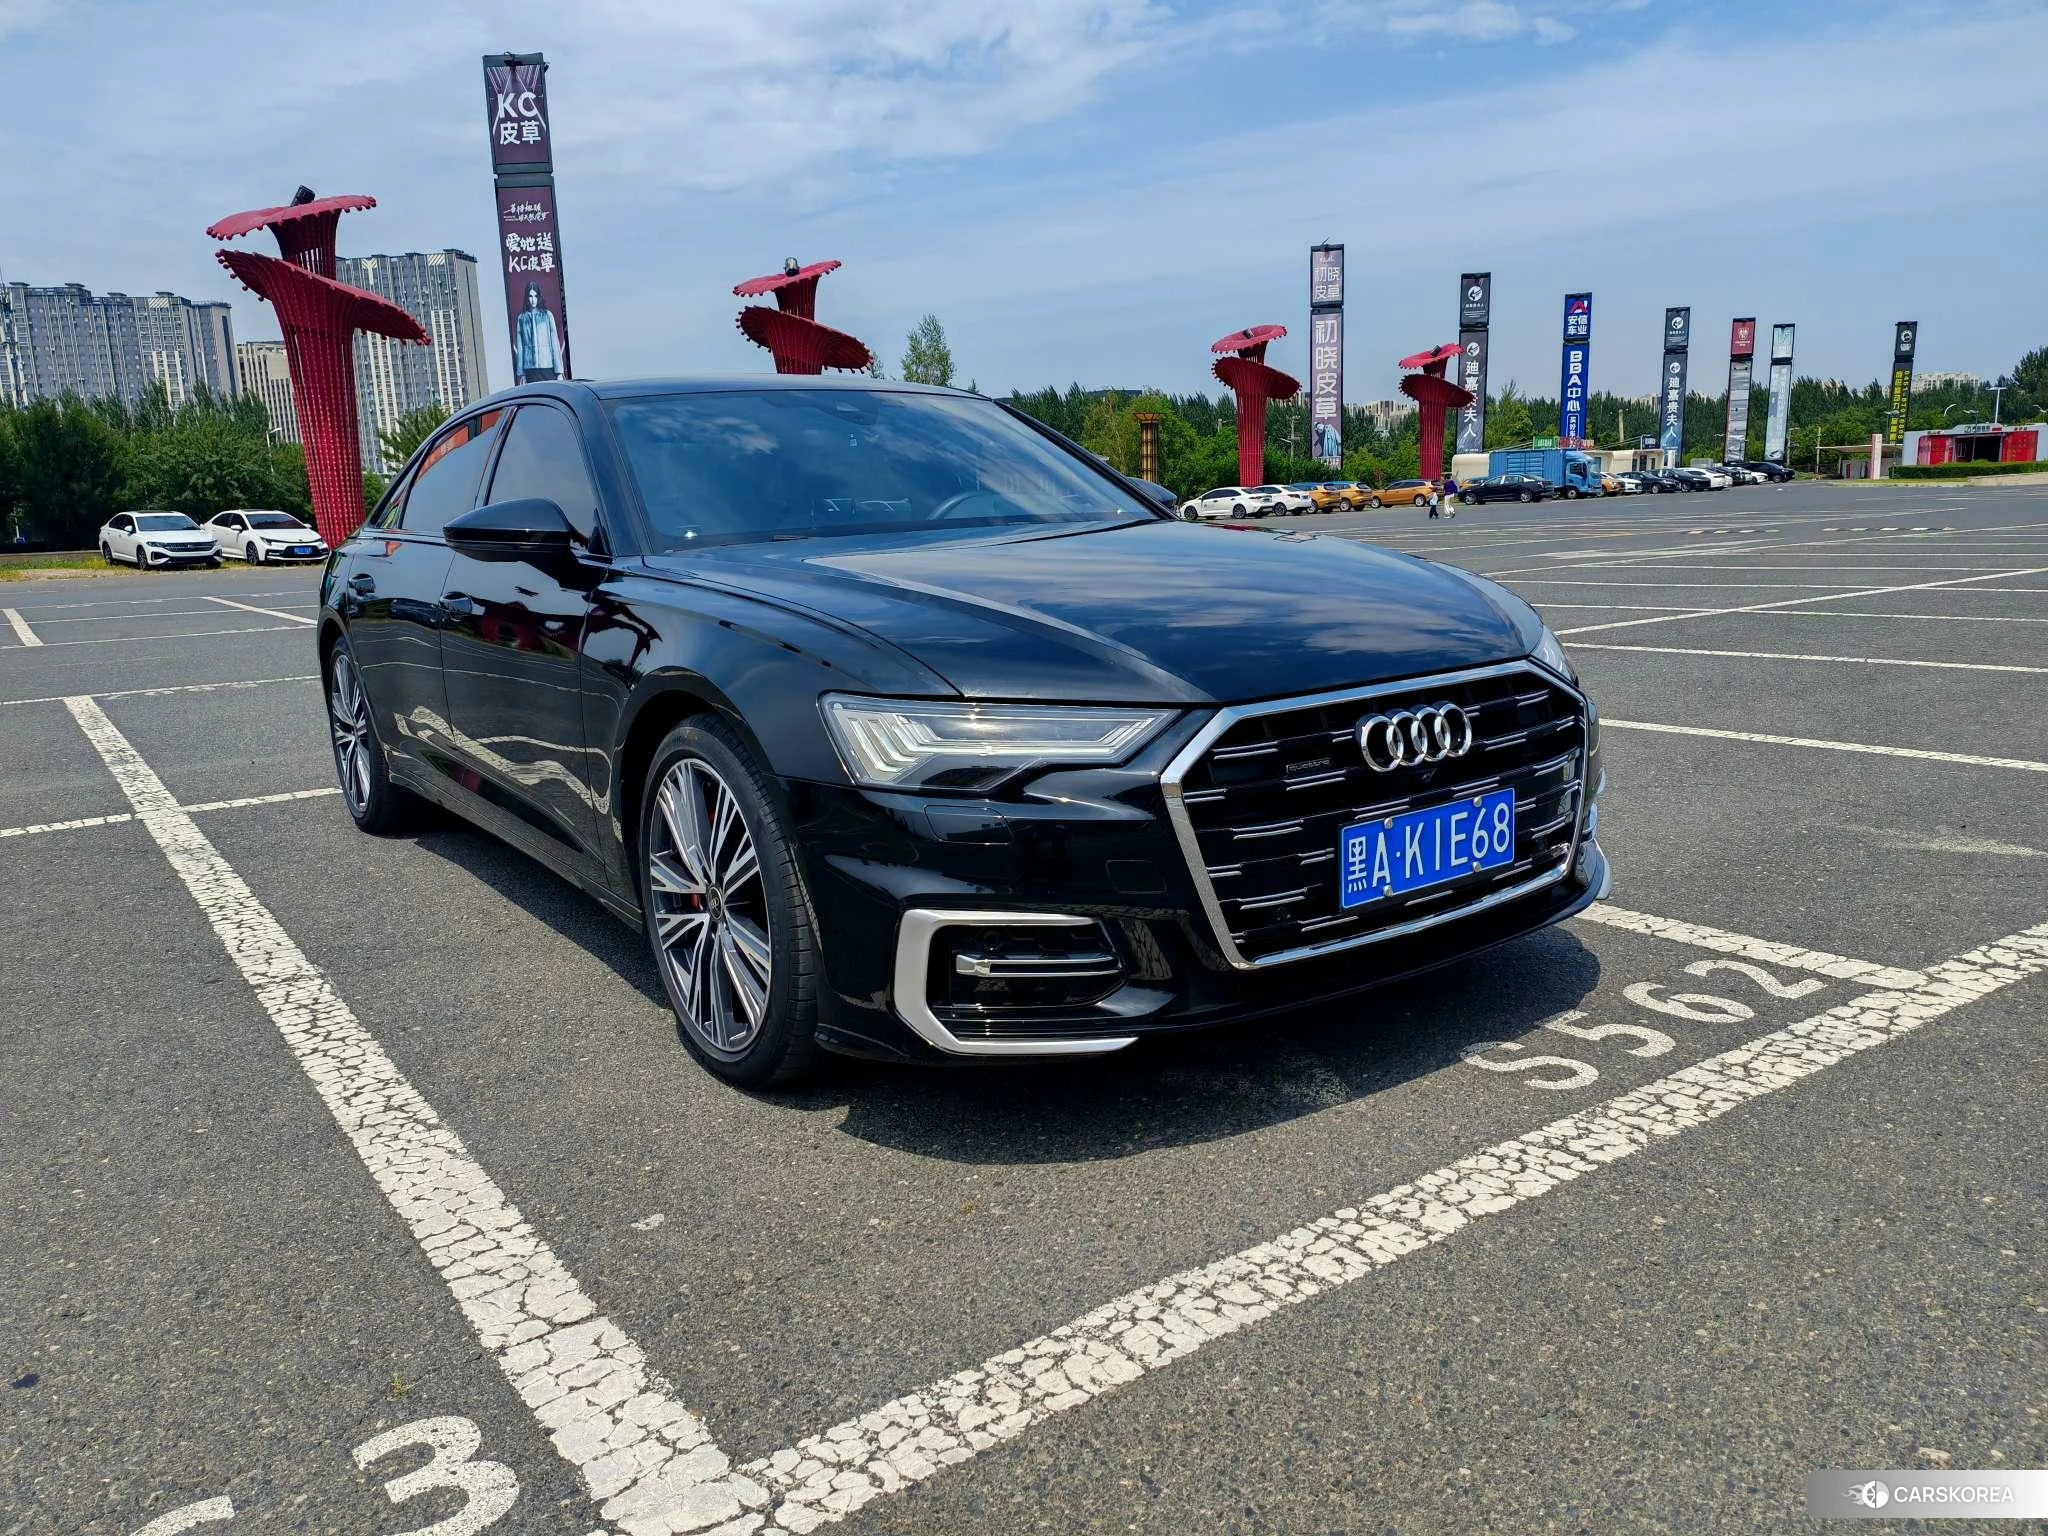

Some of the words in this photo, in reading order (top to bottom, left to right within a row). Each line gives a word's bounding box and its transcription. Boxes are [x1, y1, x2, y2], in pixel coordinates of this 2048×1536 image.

[497, 91, 538, 119] KC
[499, 120, 541, 145] 皮草
[1314, 267, 1341, 283] 初晓
[1314, 284, 1340, 299] 皮草
[1567, 315, 1588, 325] 安信
[1567, 325, 1588, 335] 车业
[1315, 319, 1338, 419] 初晓皮草
